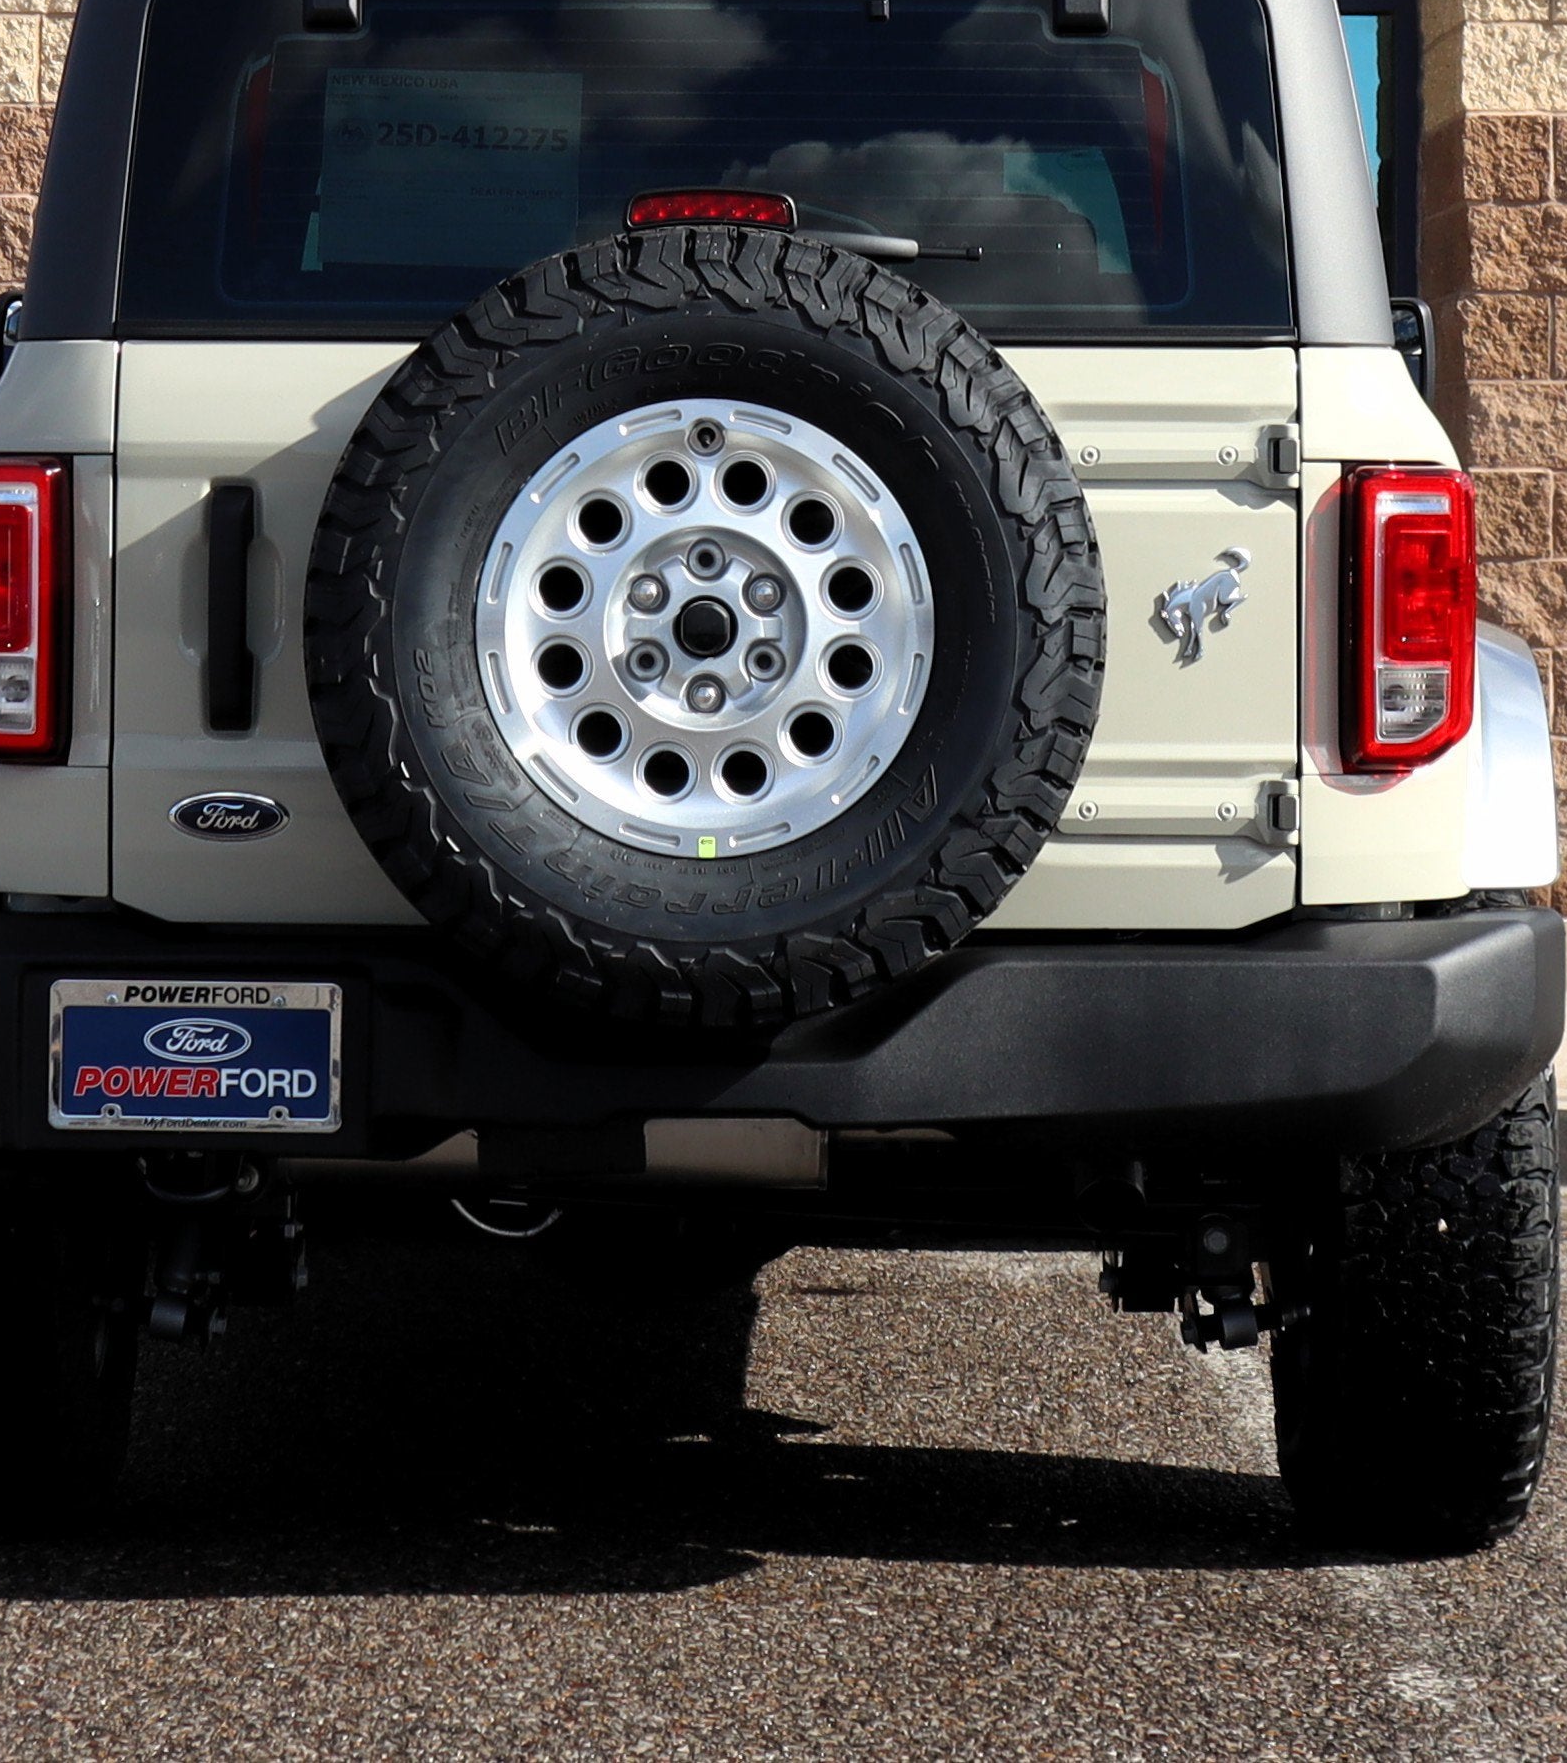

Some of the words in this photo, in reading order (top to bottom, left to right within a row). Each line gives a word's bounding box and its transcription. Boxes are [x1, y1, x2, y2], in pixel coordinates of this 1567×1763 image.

[332, 75, 365, 87] NEW
[369, 75, 424, 87] MEXICO
[429, 77, 459, 88] USA
[376, 122, 568, 151] 25D-412275
[197, 802, 260, 829] Ford
[124, 985, 270, 1005] POWERFORD
[166, 1025, 229, 1053] Ford
[74, 1066, 318, 1098] POWERFORD
